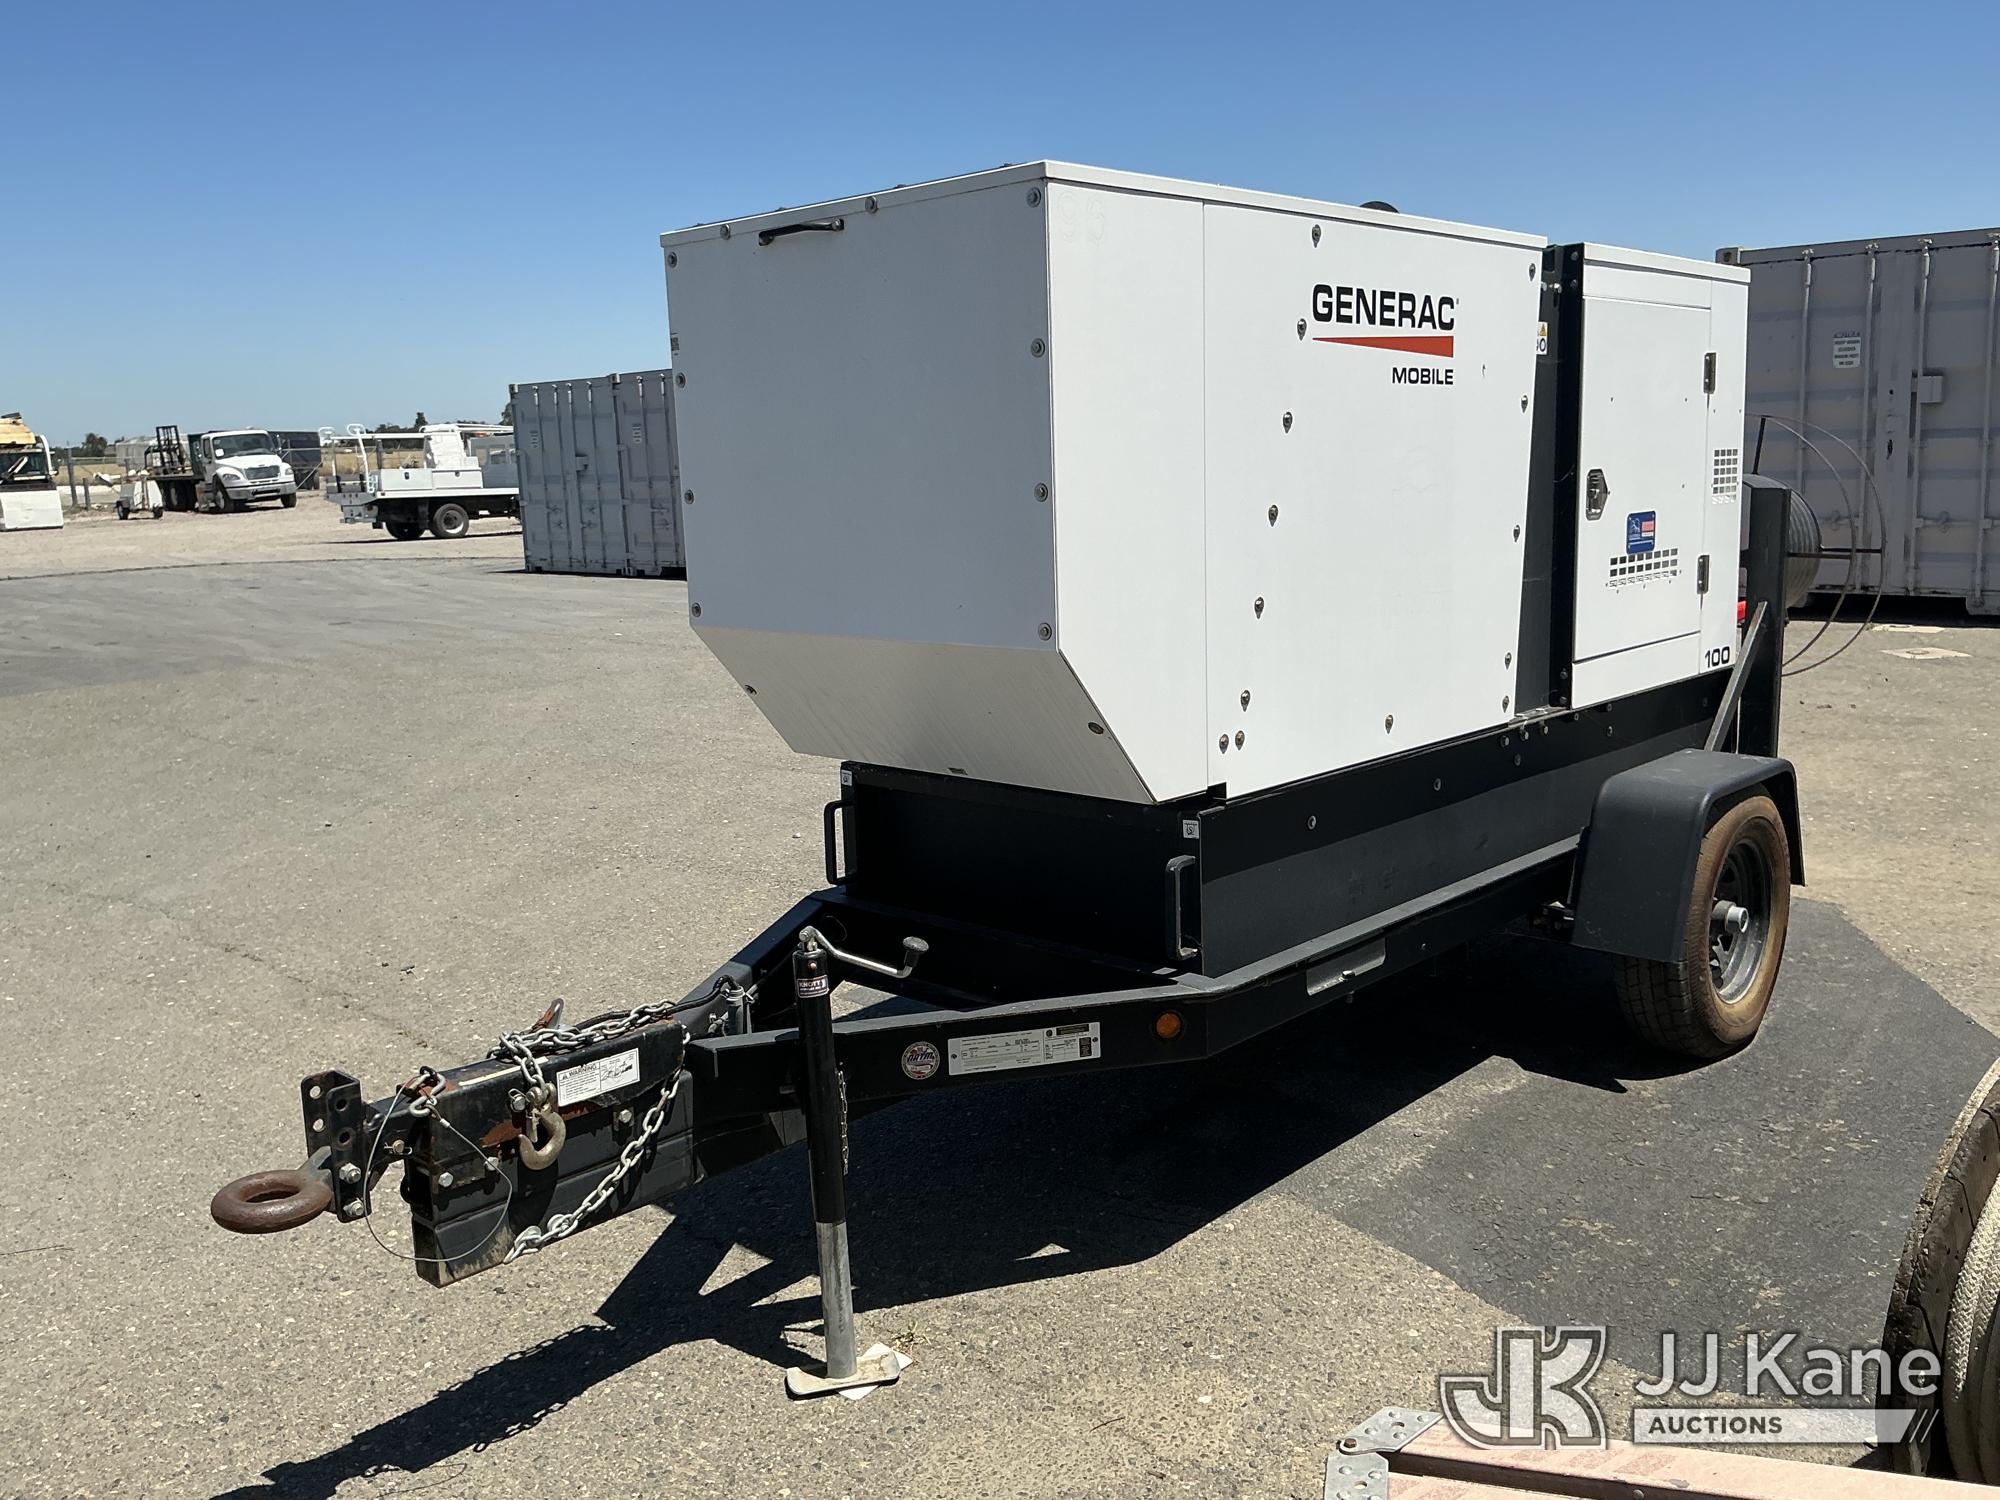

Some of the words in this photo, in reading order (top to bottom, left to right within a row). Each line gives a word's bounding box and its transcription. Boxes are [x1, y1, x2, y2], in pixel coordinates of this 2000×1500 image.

[1312, 284, 1455, 331] GENERAC
[1392, 367, 1454, 385] MOBILE
[1704, 646, 1730, 668] 100
[568, 1062, 598, 1077] WARNING
